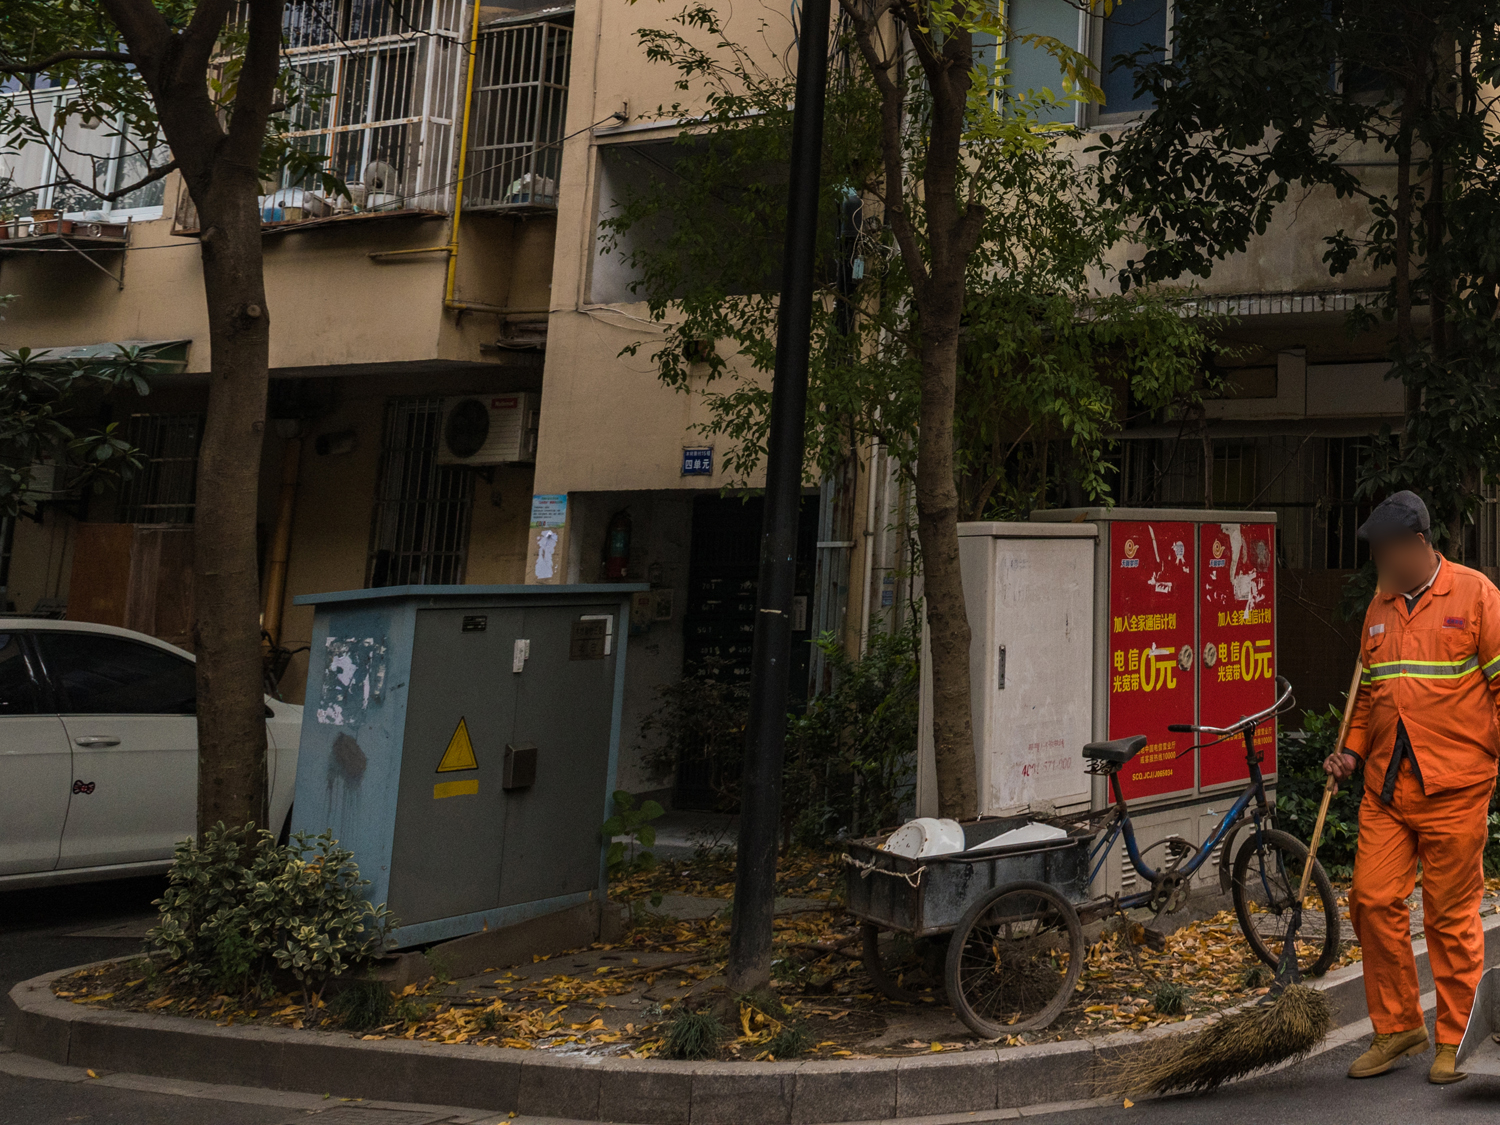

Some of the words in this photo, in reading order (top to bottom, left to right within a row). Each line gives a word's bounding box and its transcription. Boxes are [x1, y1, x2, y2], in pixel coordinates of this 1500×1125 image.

[685, 458, 710, 470] 四单元
[1113, 612, 1177, 633] 加入全家通信计划
[1114, 648, 1140, 672] 电信
[1218, 641, 1240, 663] 电信
[1240, 639, 1273, 682] 0元
[1140, 646, 1177, 693] 0元
[1217, 663, 1241, 683] 光宽带
[1112, 673, 1140, 693] 光宽带
[1136, 740, 1176, 754] 地中国电信营业厅
